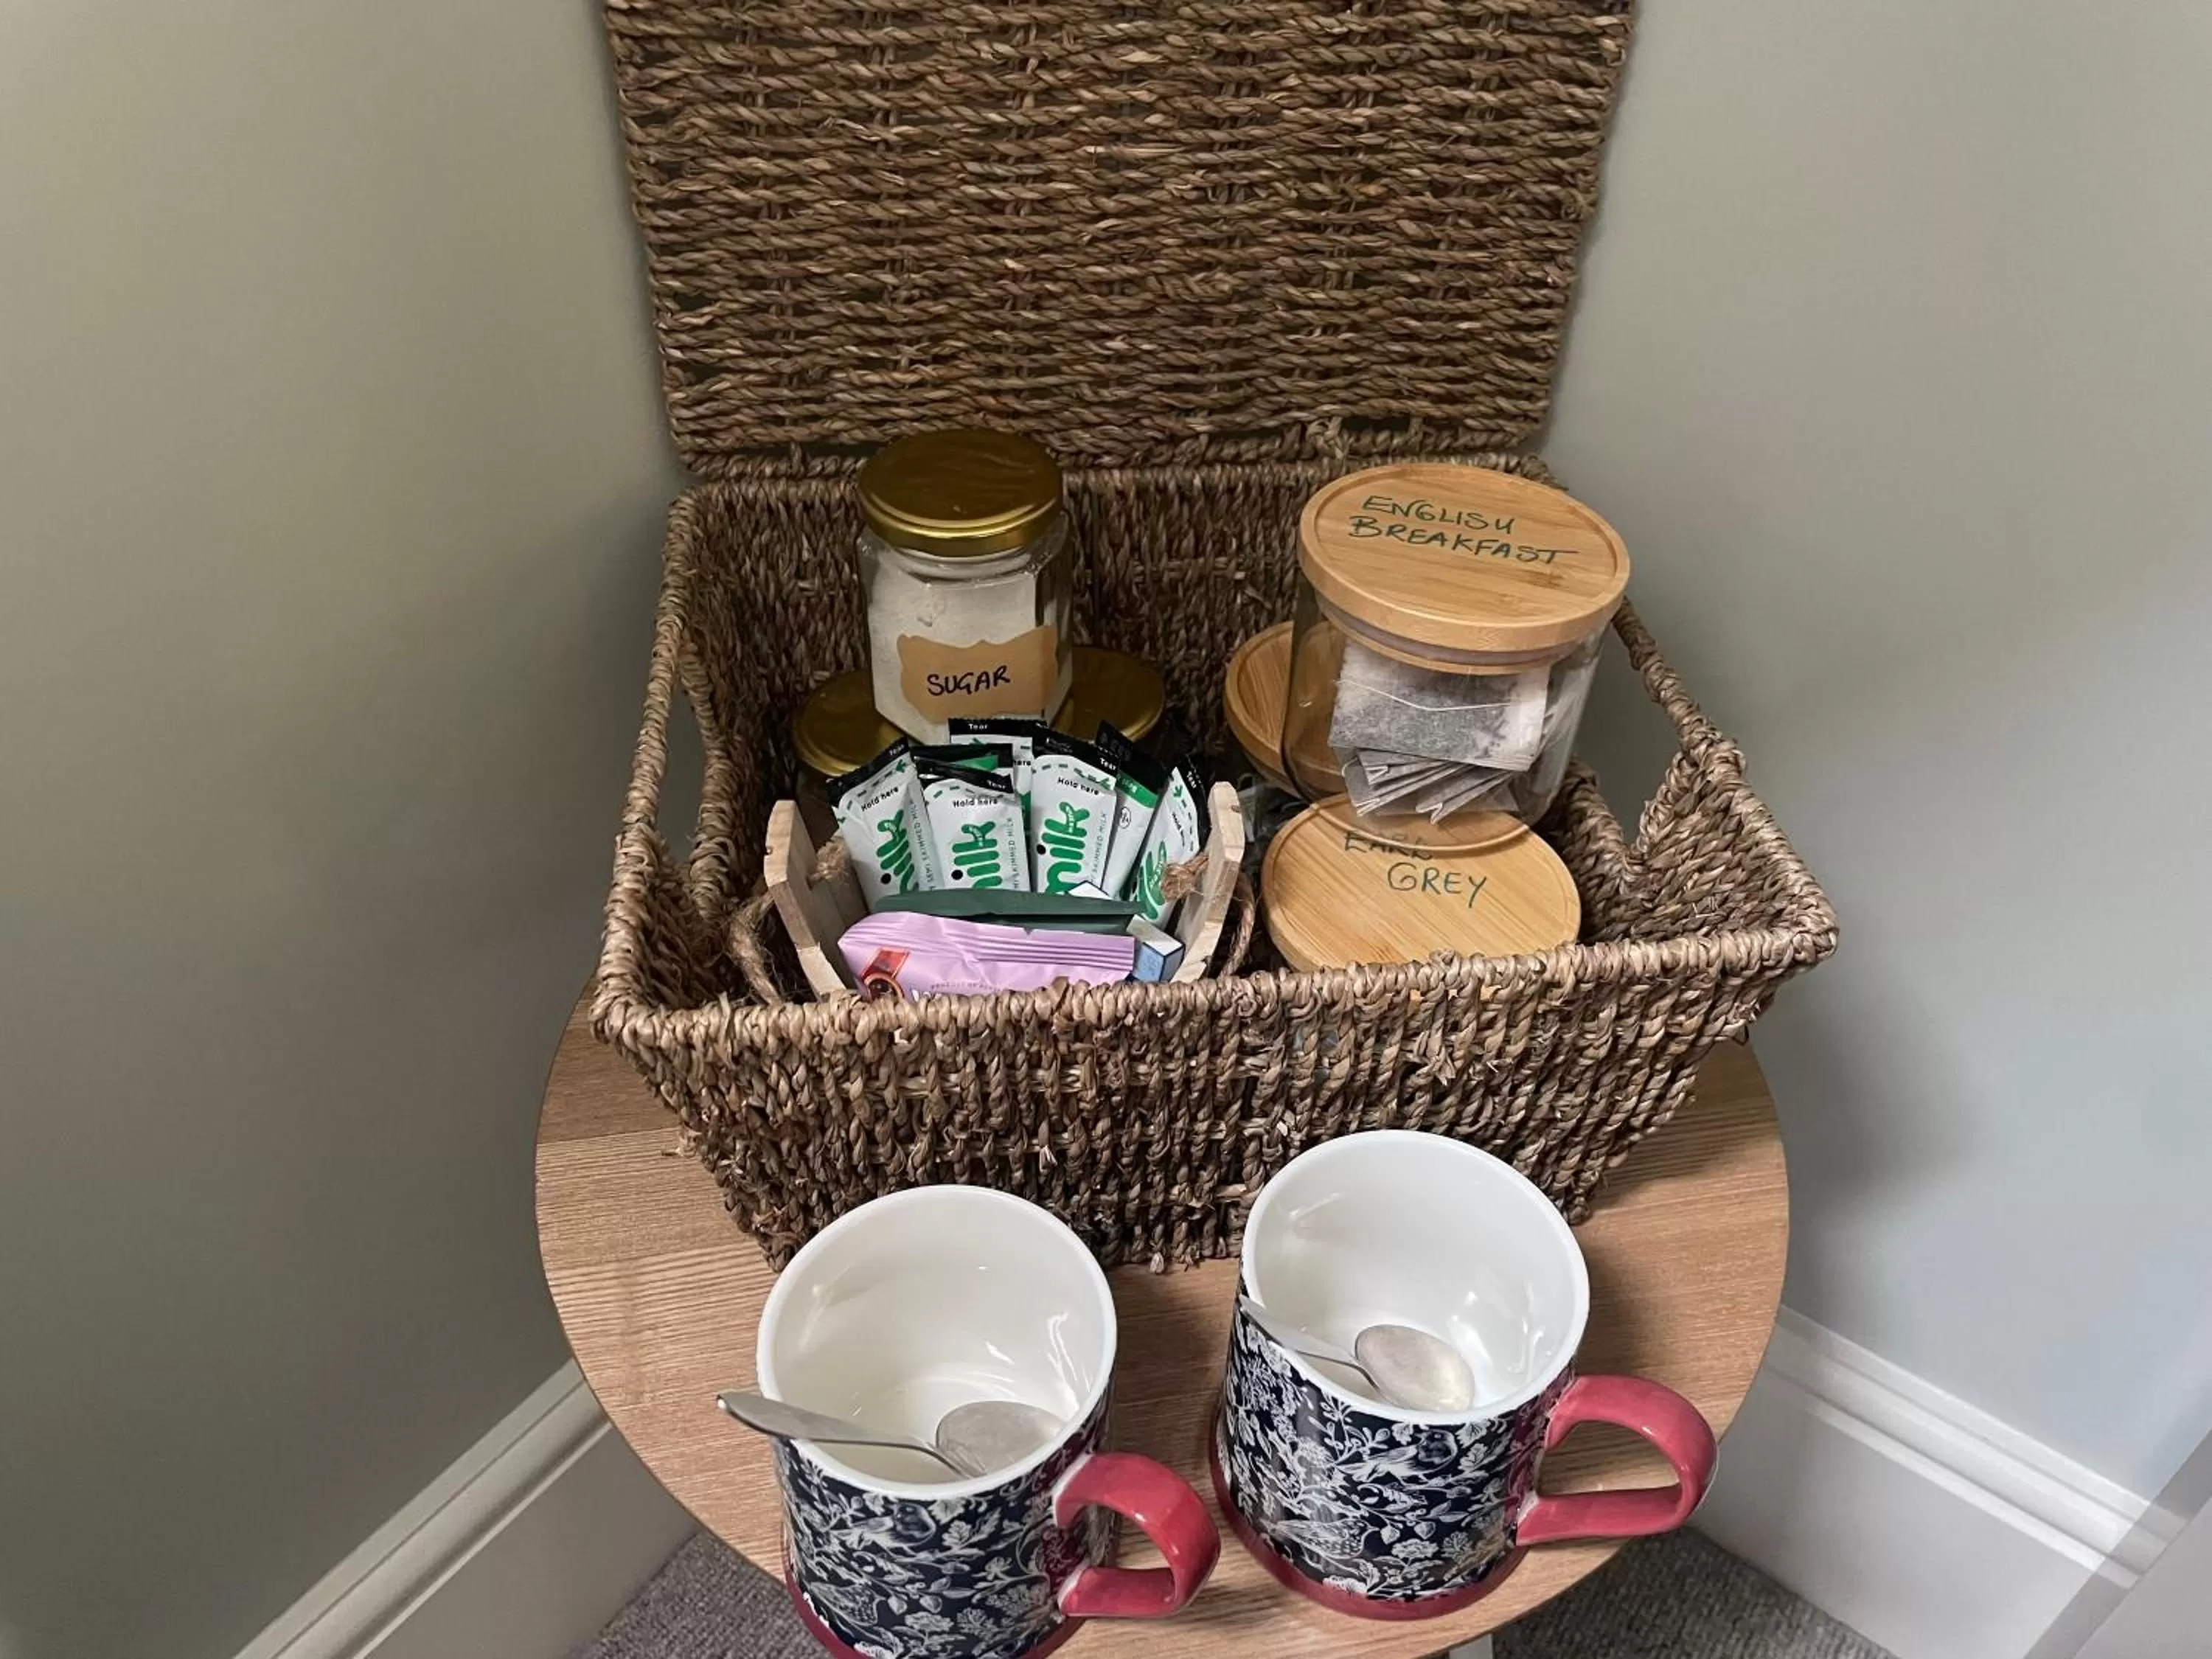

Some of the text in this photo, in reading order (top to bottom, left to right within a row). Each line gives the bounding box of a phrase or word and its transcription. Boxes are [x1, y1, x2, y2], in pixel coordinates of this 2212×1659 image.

[1363, 495, 1515, 535] ENGLISH
[1349, 516, 1579, 565] BREAKFAST
[927, 665, 1011, 696] SUGAR
[1099, 757, 1116, 771] Tear
[861, 787, 899, 811] Hold here
[1057, 776, 1099, 796] Hold here
[953, 796, 998, 808] Hold here
[1388, 862, 1487, 908] GREY
